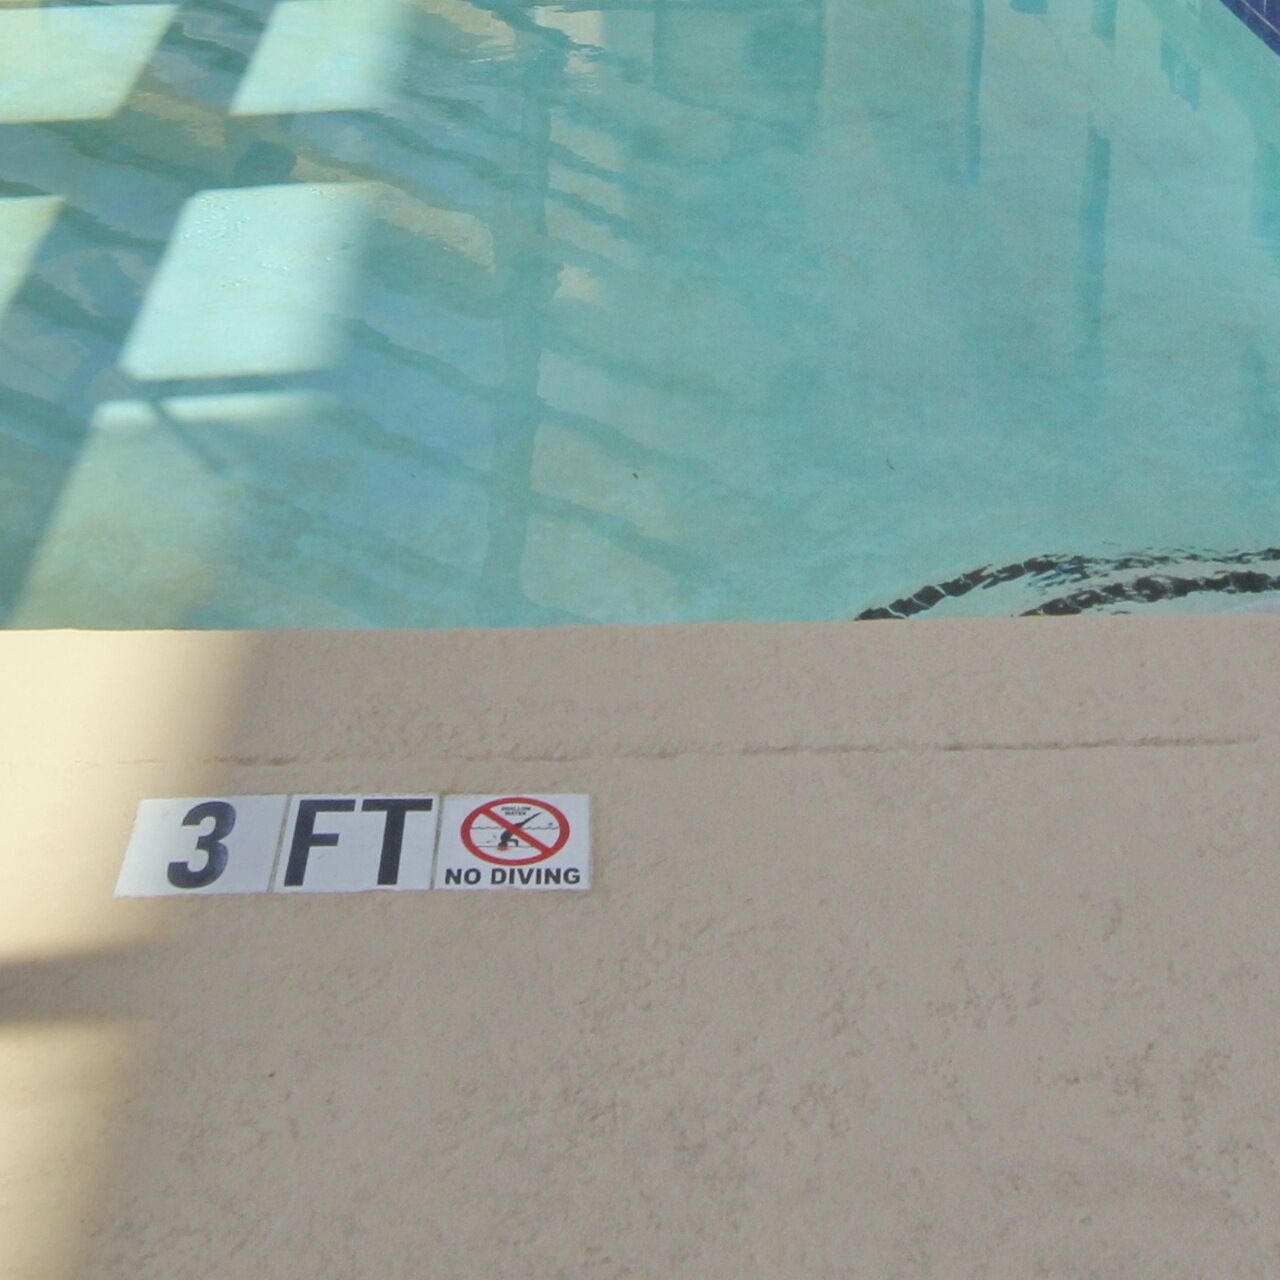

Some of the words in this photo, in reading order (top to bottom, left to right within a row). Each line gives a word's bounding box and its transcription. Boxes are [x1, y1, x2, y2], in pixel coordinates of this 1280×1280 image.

[166, 800, 237, 890] 3
[283, 798, 433, 888] FT
[444, 867, 481, 886] NO
[490, 867, 582, 886] DIVING
